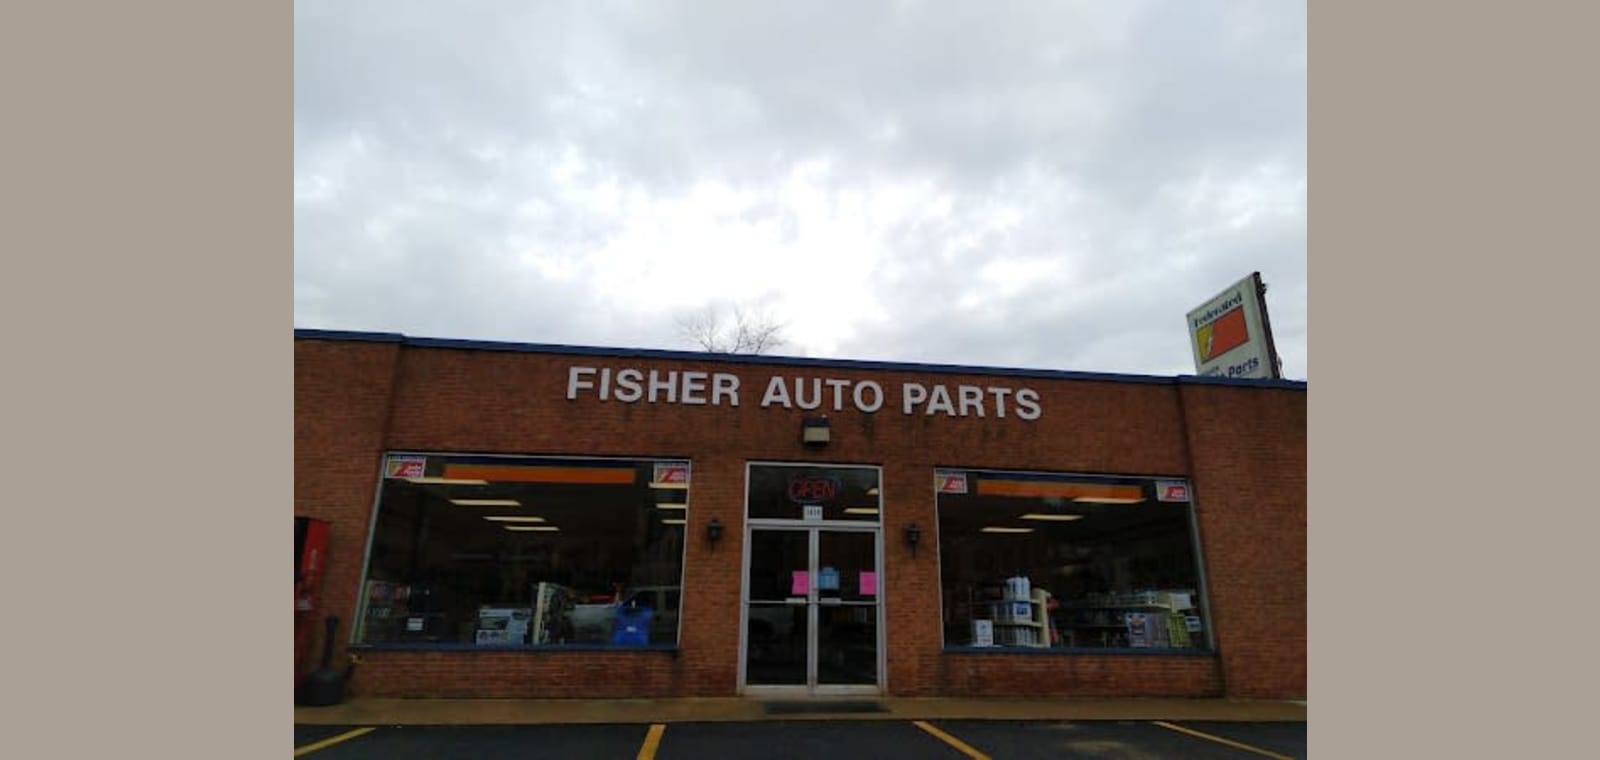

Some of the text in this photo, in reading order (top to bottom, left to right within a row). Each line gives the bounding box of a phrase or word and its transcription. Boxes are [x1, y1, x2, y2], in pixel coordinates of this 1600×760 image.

[1229, 357, 1259, 379] Parts
[566, 367, 1042, 420] FISHER AUTO PARTS
[791, 479, 835, 498] OPEN
